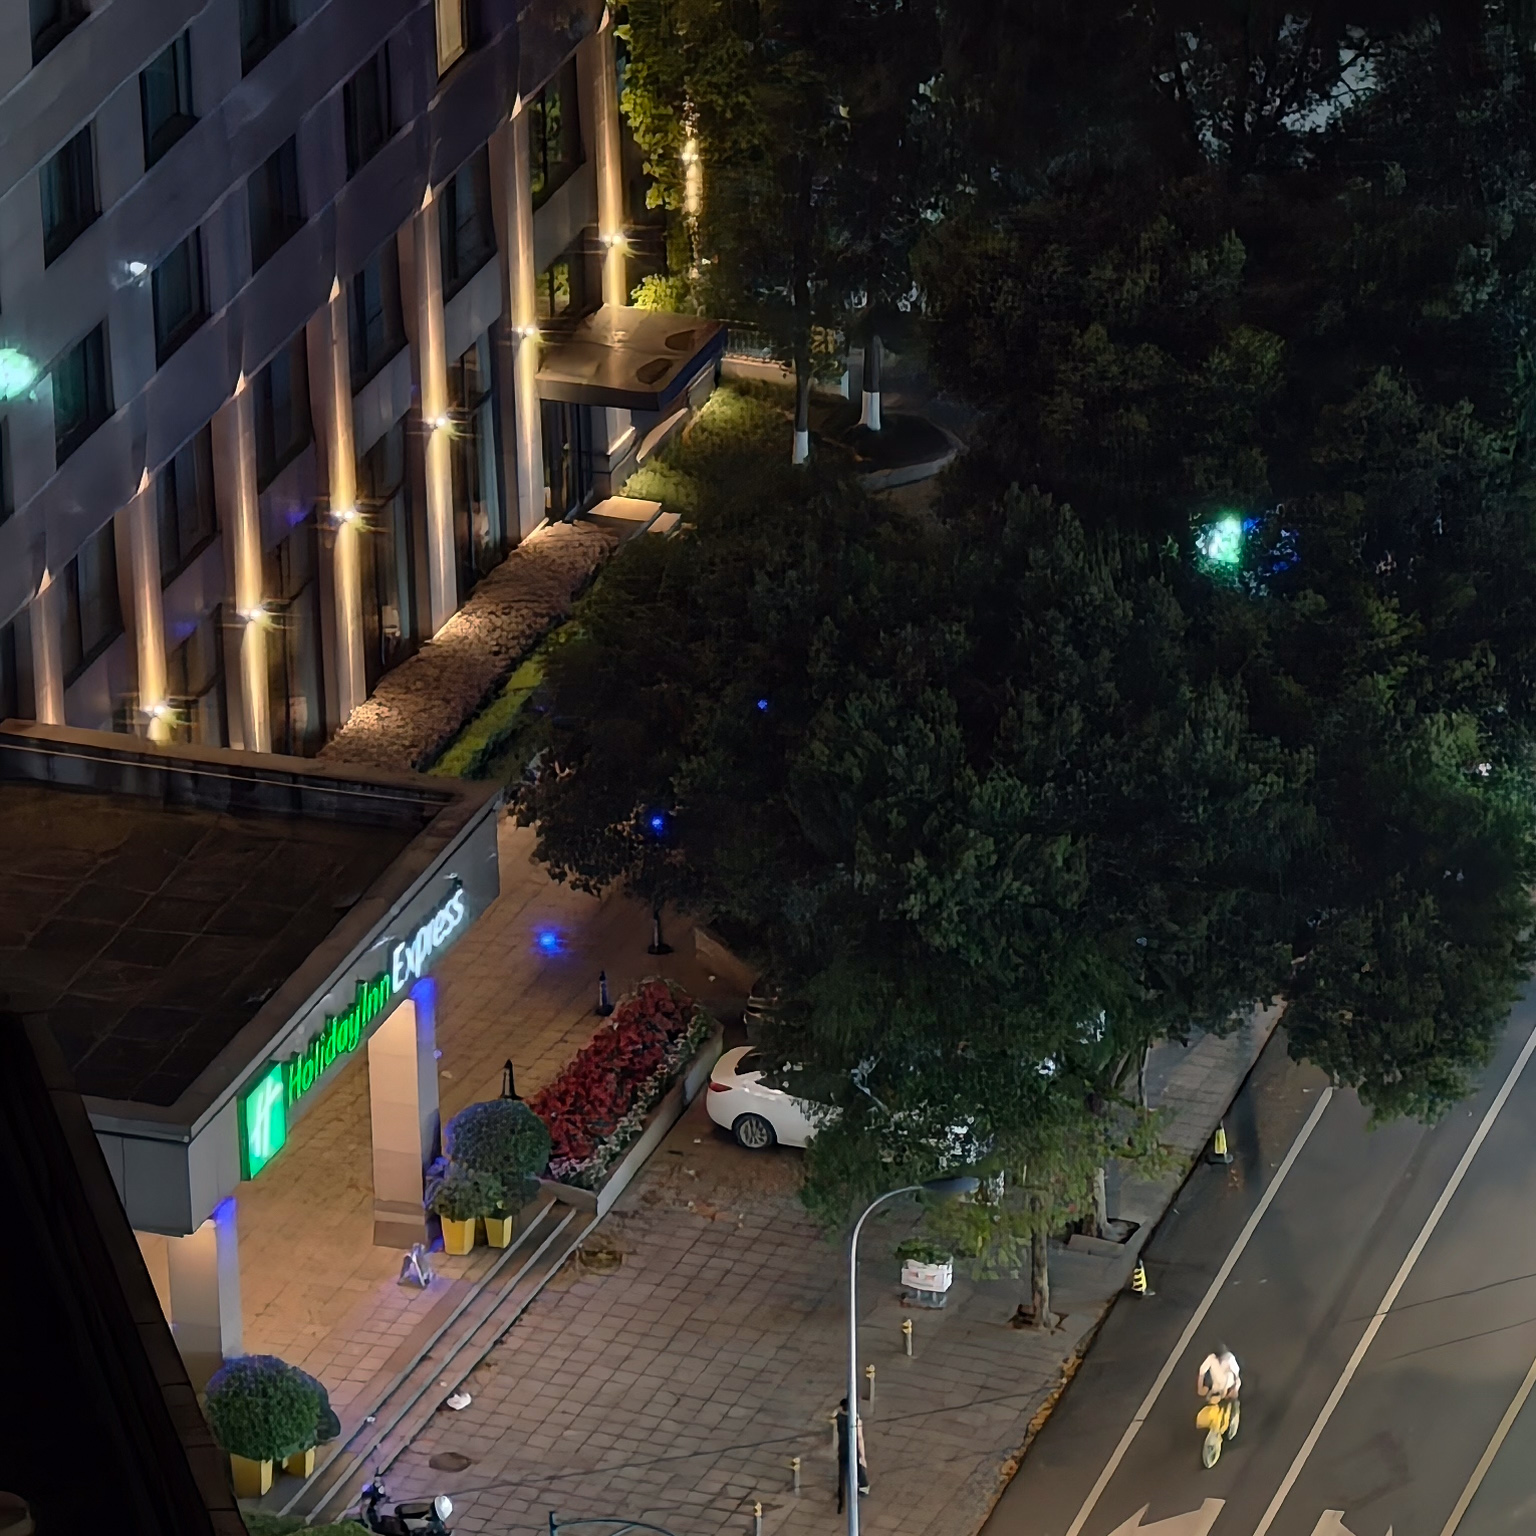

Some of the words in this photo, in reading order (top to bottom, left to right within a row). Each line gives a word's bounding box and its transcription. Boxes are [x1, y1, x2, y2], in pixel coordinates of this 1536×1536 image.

[288, 1004, 360, 1102] Holiday
[362, 972, 391, 1027] Inn
[391, 886, 466, 995] Express
